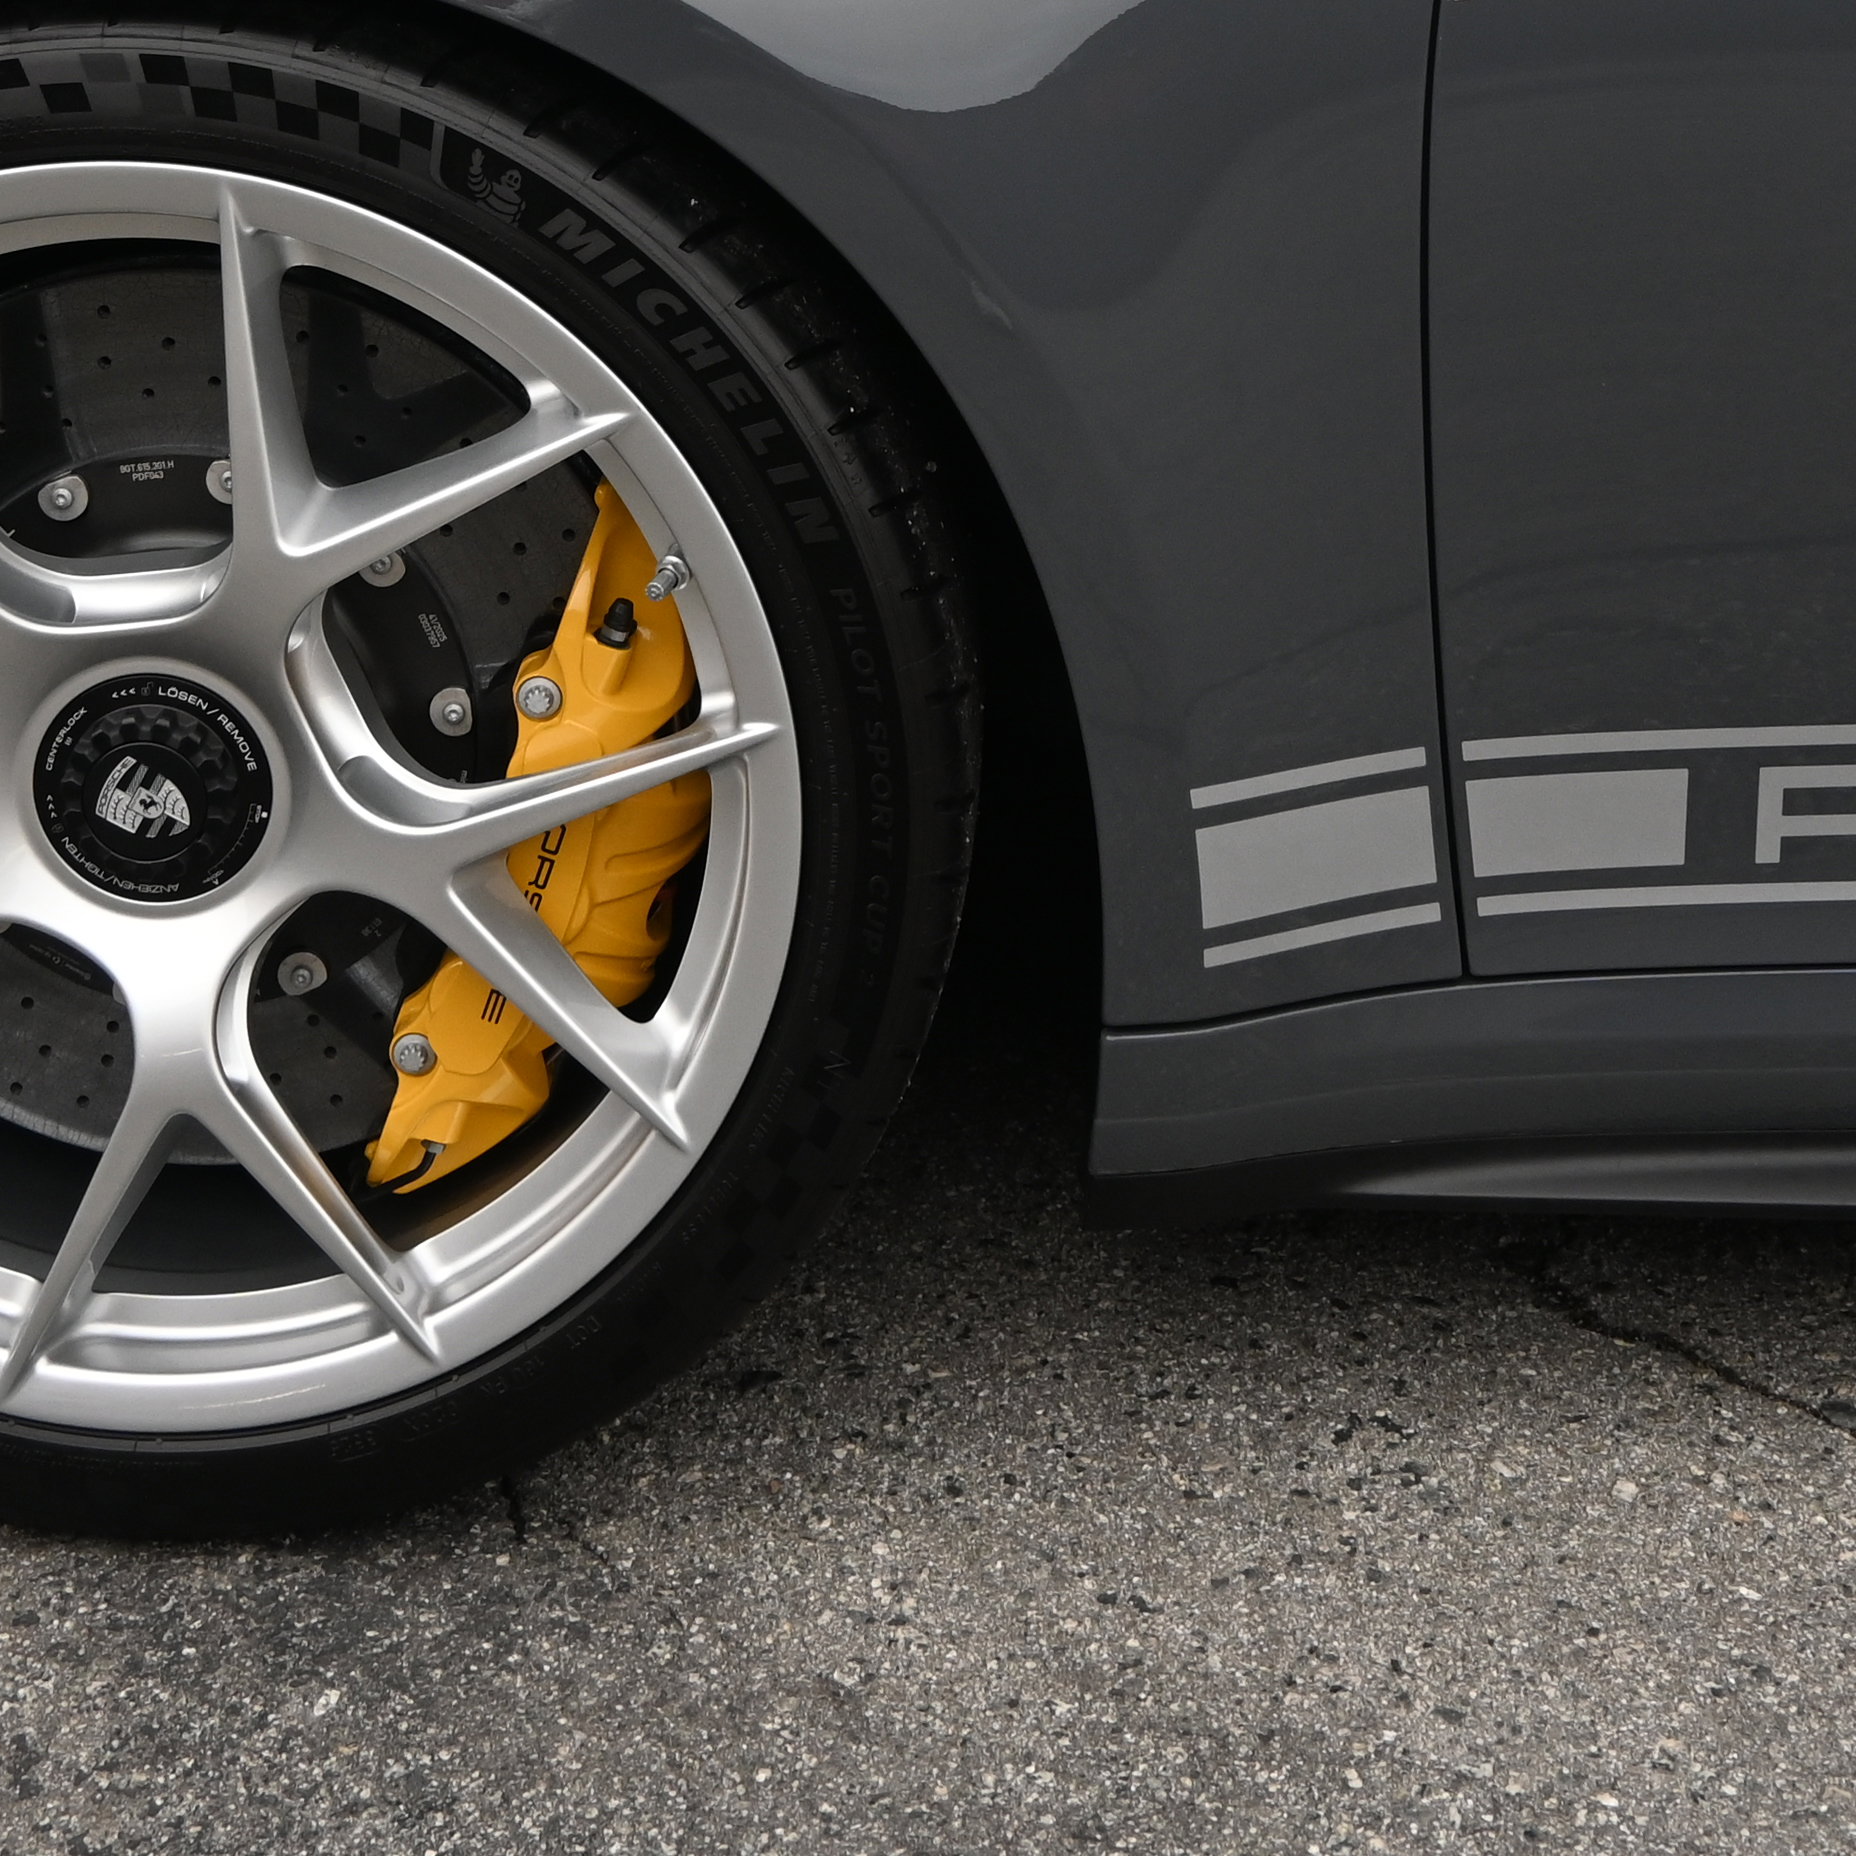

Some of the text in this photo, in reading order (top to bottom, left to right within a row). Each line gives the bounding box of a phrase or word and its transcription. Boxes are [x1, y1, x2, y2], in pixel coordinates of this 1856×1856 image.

[537, 200, 840, 551] MICHELIN
[828, 583, 883, 704] PILOT
[46, 706, 87, 772] CENTERLOCK
[158, 686, 209, 712] LÖSEN
[217, 713, 258, 772] REMOVE
[97, 757, 134, 815] PORSCHE
[863, 717, 893, 860] SPORT
[857, 872, 892, 956] CUP
